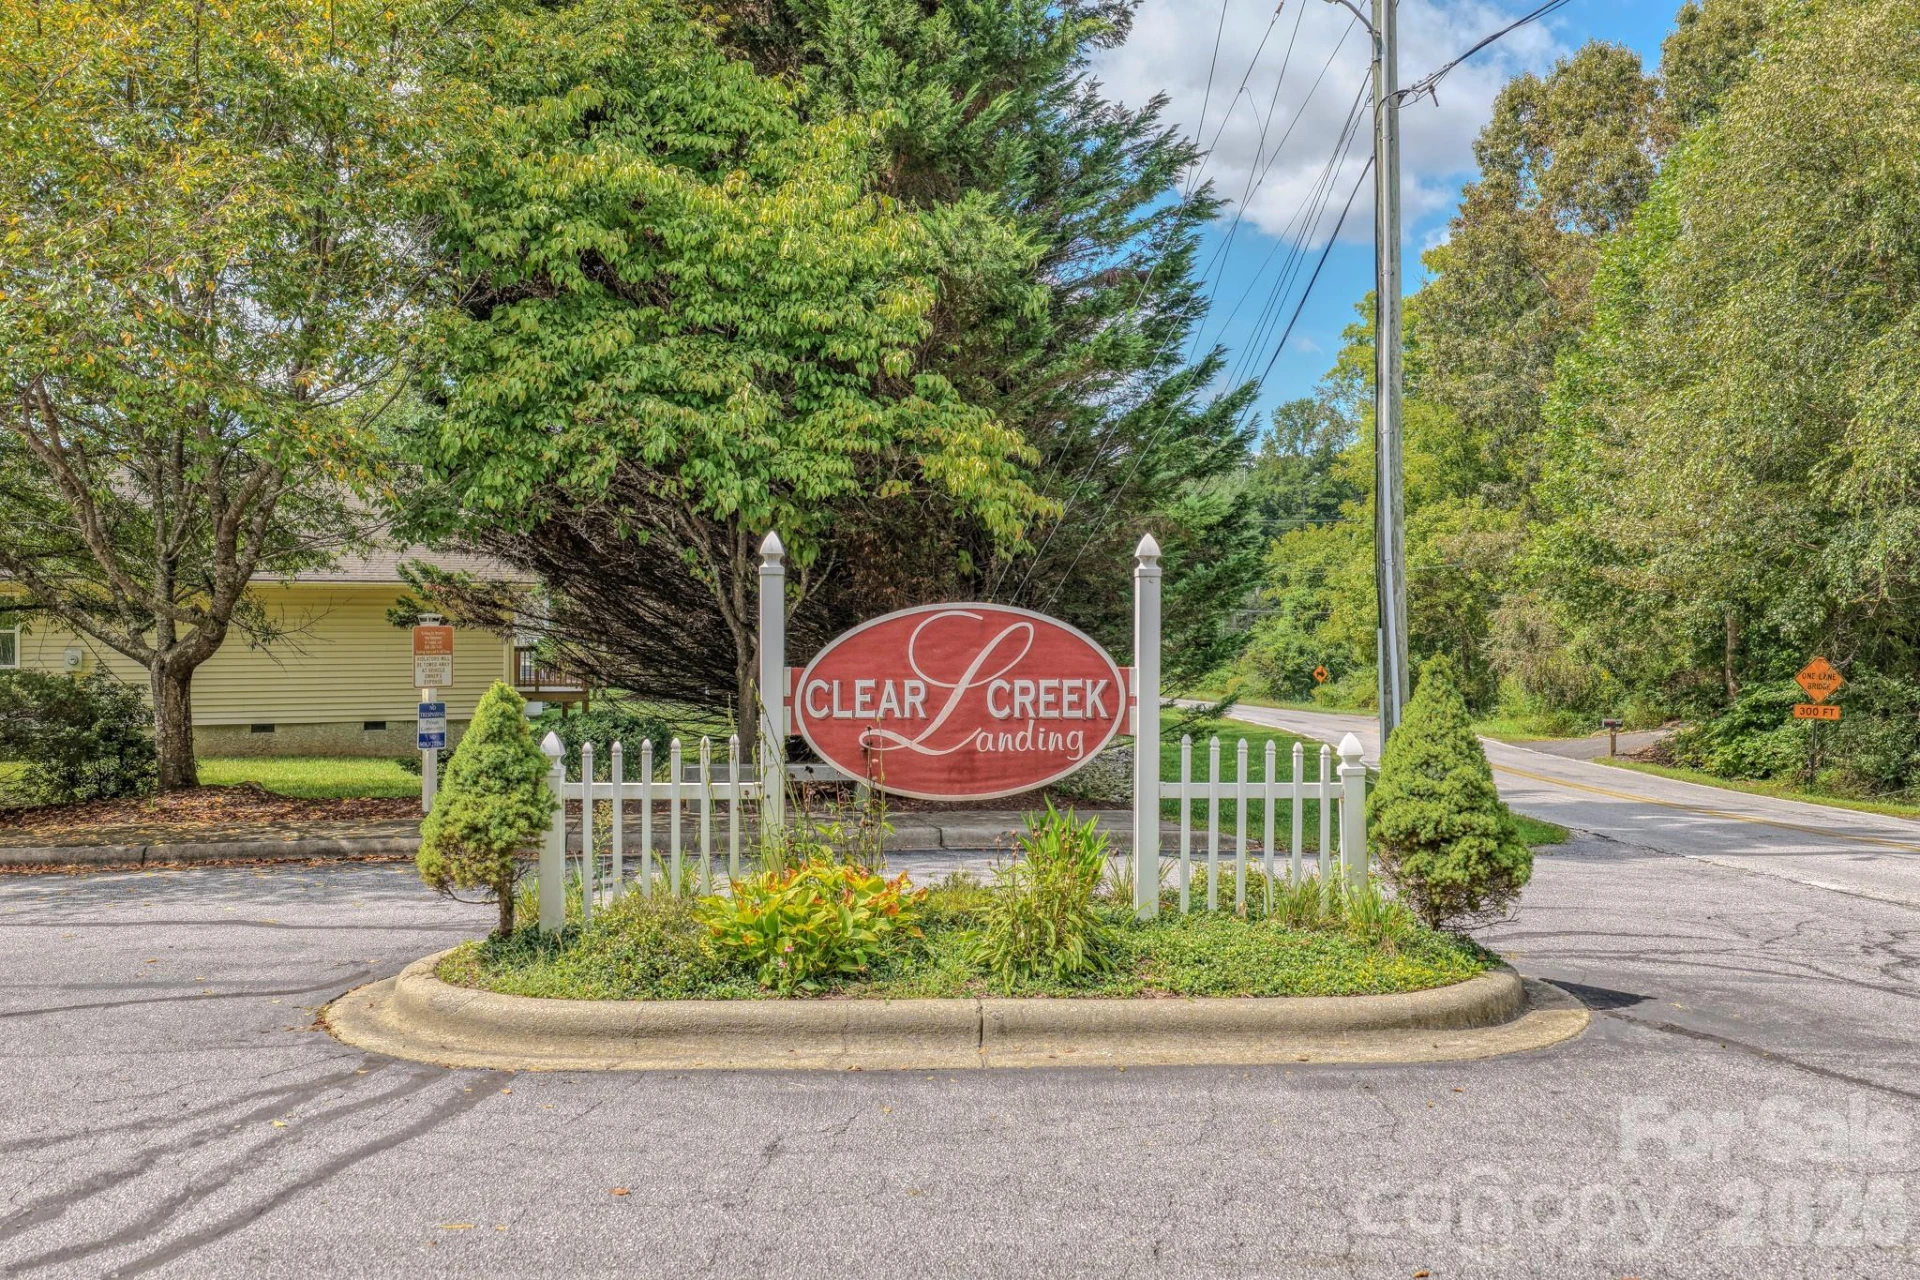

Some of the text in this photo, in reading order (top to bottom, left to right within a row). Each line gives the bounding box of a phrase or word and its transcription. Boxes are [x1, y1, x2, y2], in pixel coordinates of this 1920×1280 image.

[1819, 672, 1837, 681] LANE
[805, 678, 1111, 720] CLEAR CREEK
[1799, 707, 1835, 717] 300 FT
